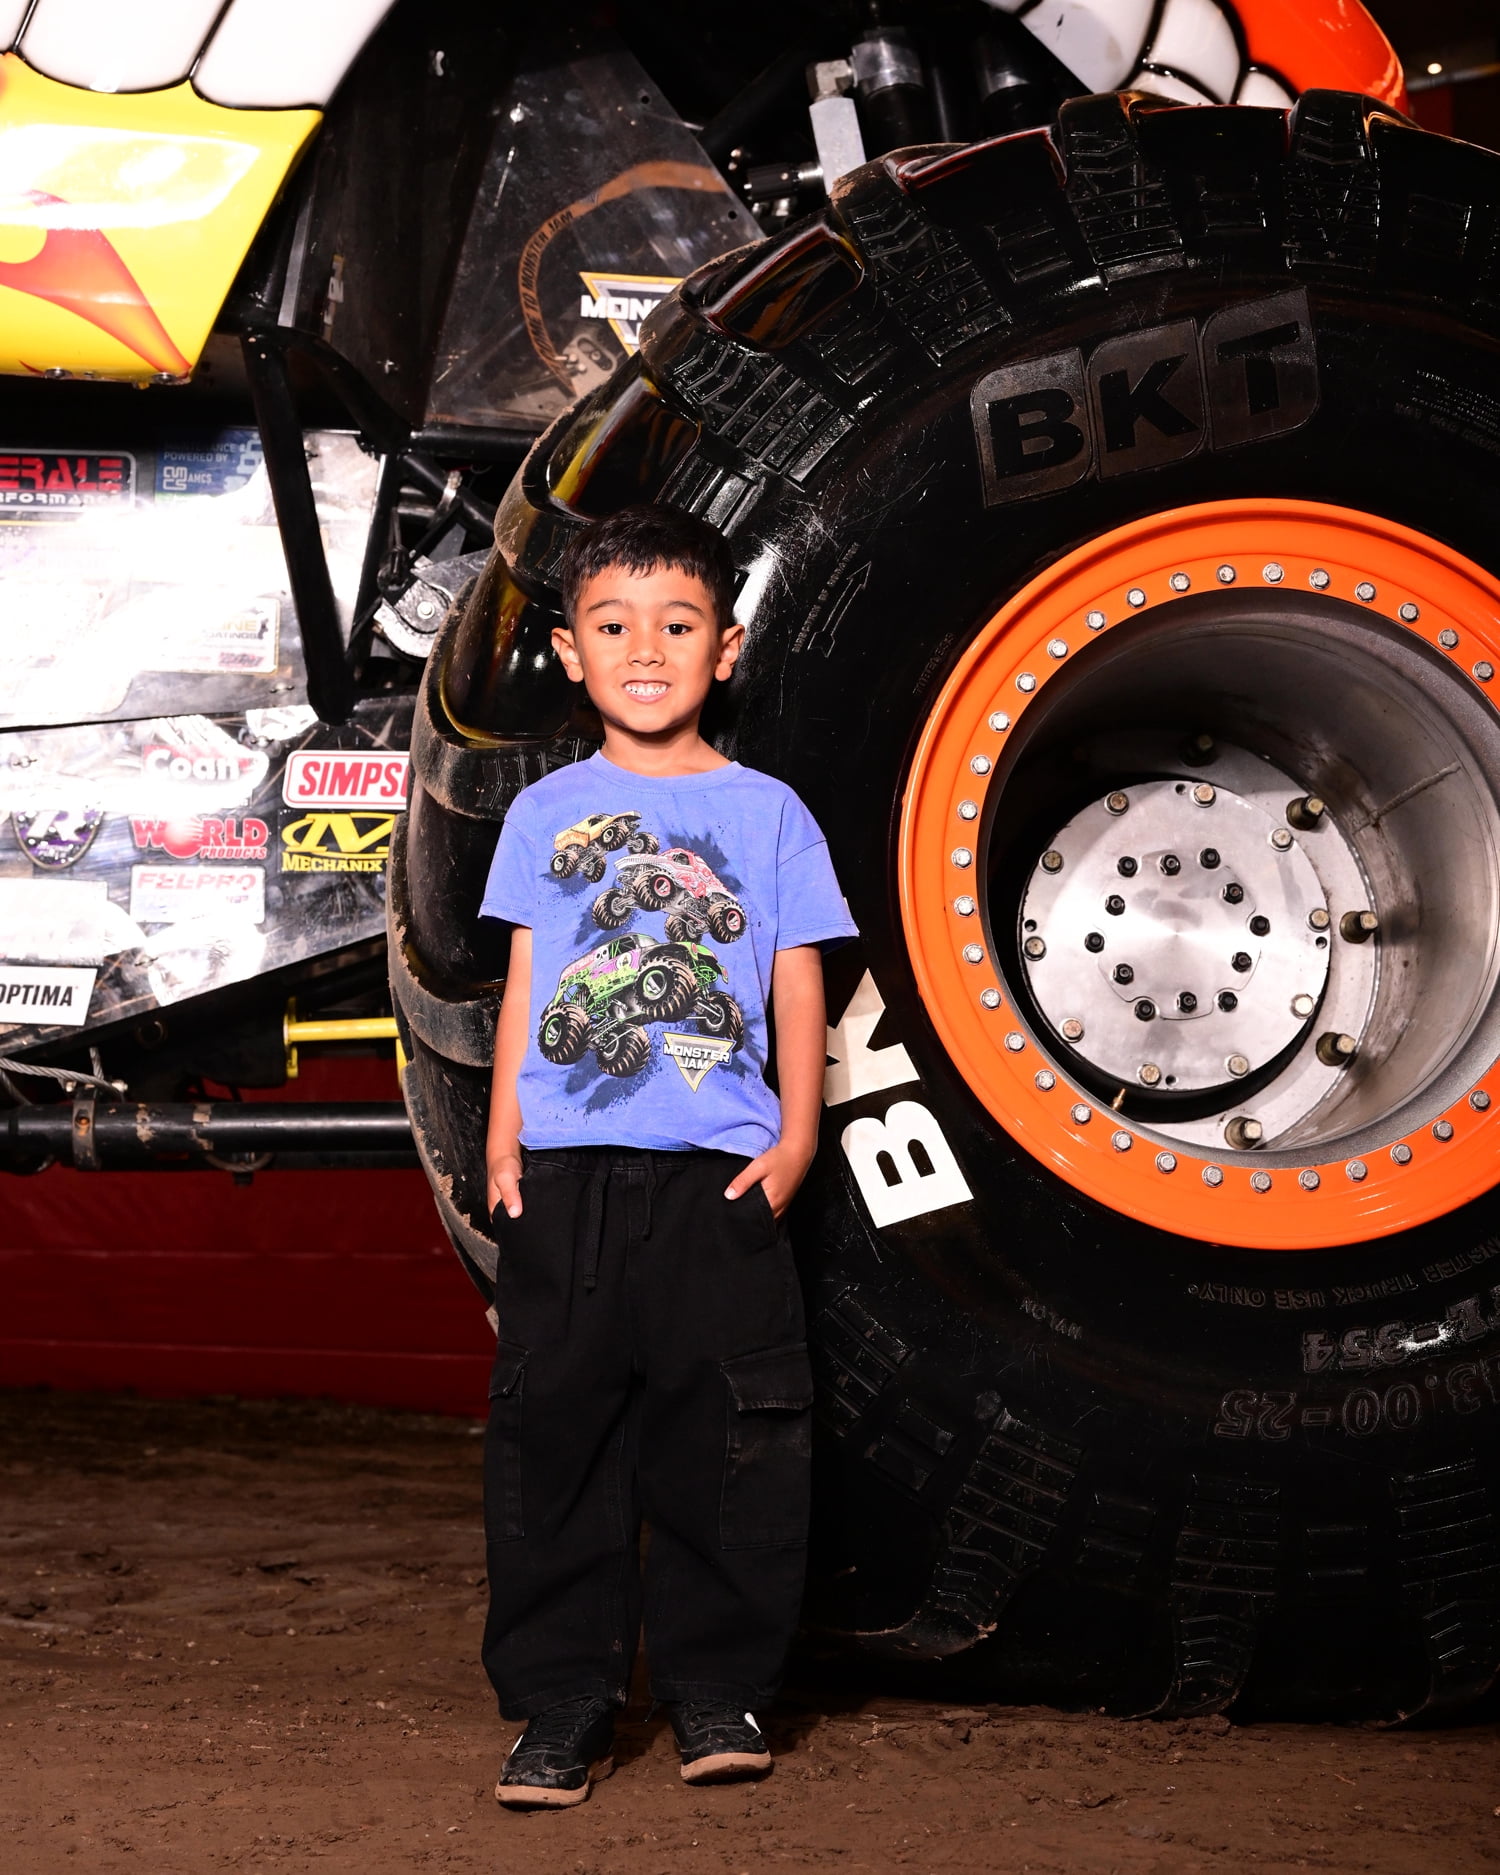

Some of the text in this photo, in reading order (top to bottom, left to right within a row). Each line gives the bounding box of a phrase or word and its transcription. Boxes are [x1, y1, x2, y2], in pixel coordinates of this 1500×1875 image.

[547, 210, 574, 234] JAM
[521, 232, 550, 291] MONSTER
[525, 292, 541, 310] TO
[984, 318, 1305, 480] BKT
[163, 451, 229, 463] POWERED BY
[144, 748, 241, 782] Coan
[132, 817, 268, 859] WORLD
[199, 847, 267, 860] PRODUCTS
[281, 852, 383, 872] MECHANIX
[664, 1043, 730, 1063] MONSTER
[679, 1057, 709, 1071] JAM
[1276, 1288, 1325, 1309] USE
[1336, 1273, 1420, 1306] TRUCK
